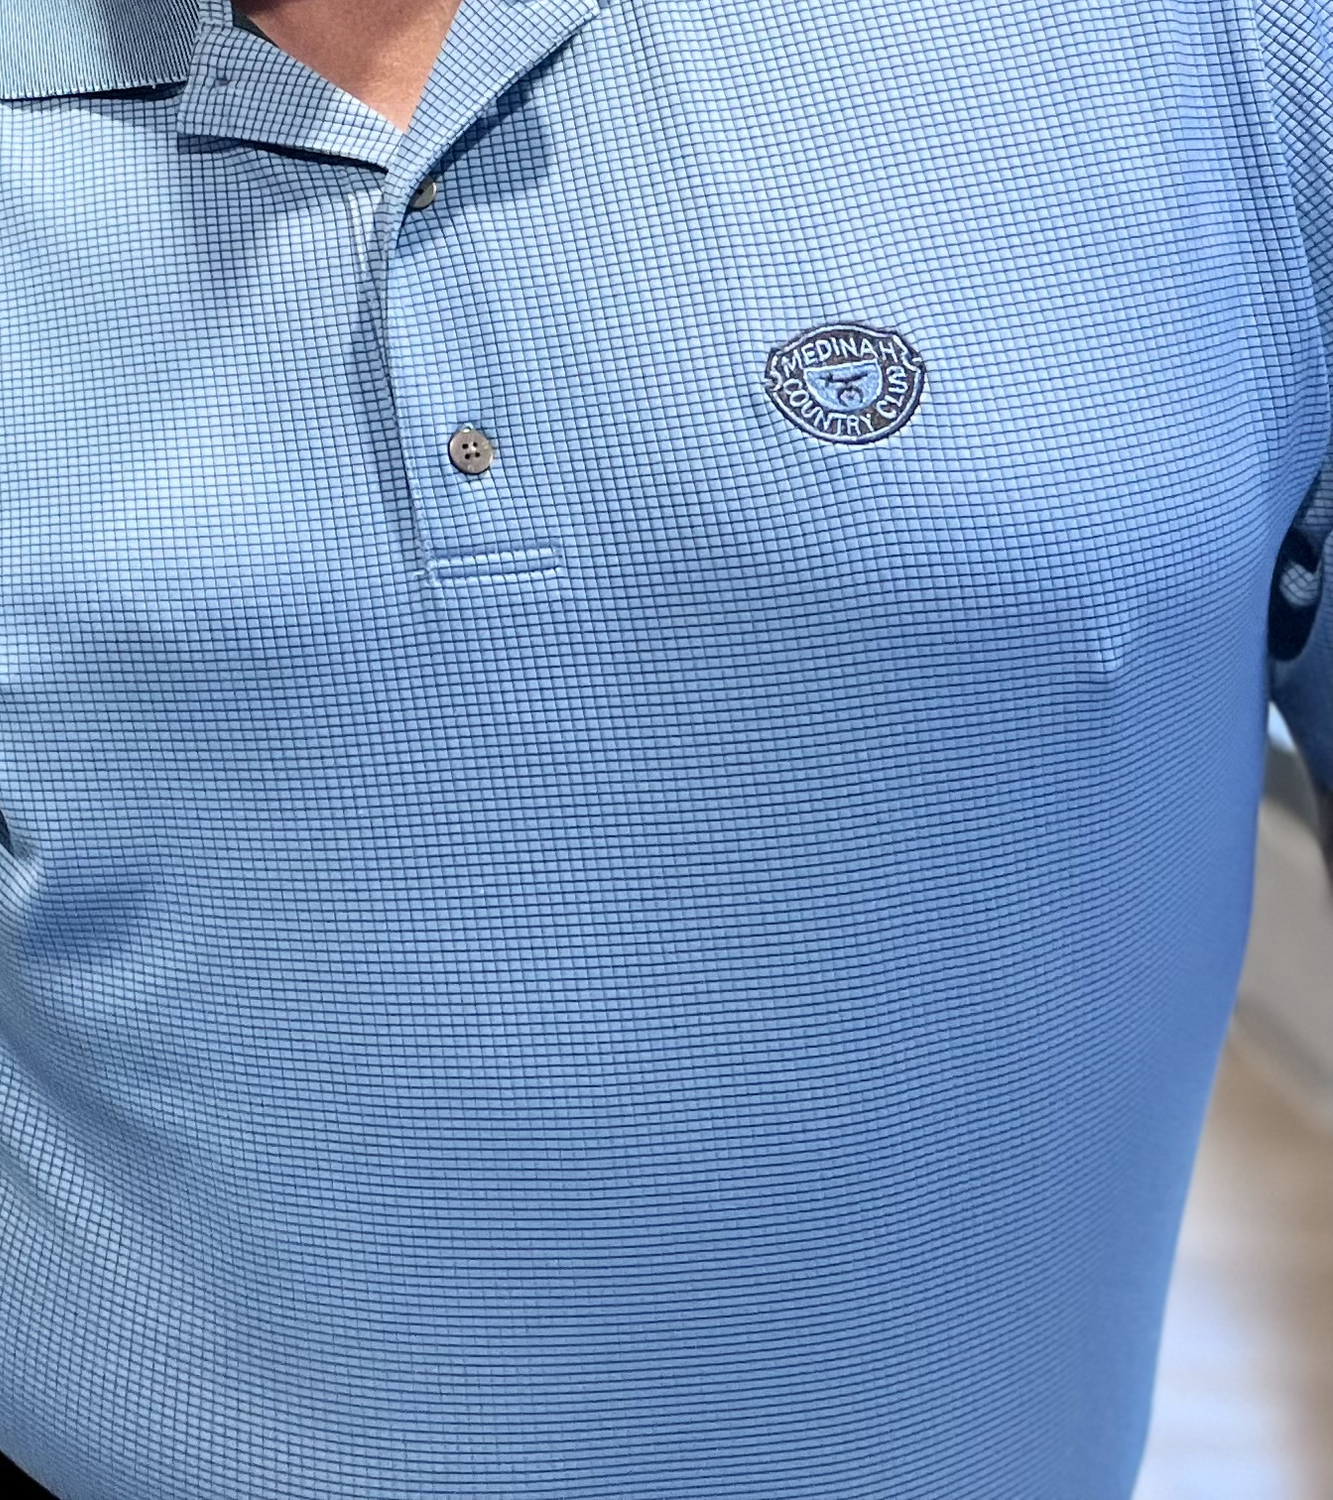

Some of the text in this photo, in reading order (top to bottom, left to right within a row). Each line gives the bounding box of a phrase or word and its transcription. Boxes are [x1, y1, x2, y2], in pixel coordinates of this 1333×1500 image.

[782, 337, 898, 376] MEDINAH
[783, 366, 909, 436] COUNTRY CLUB
